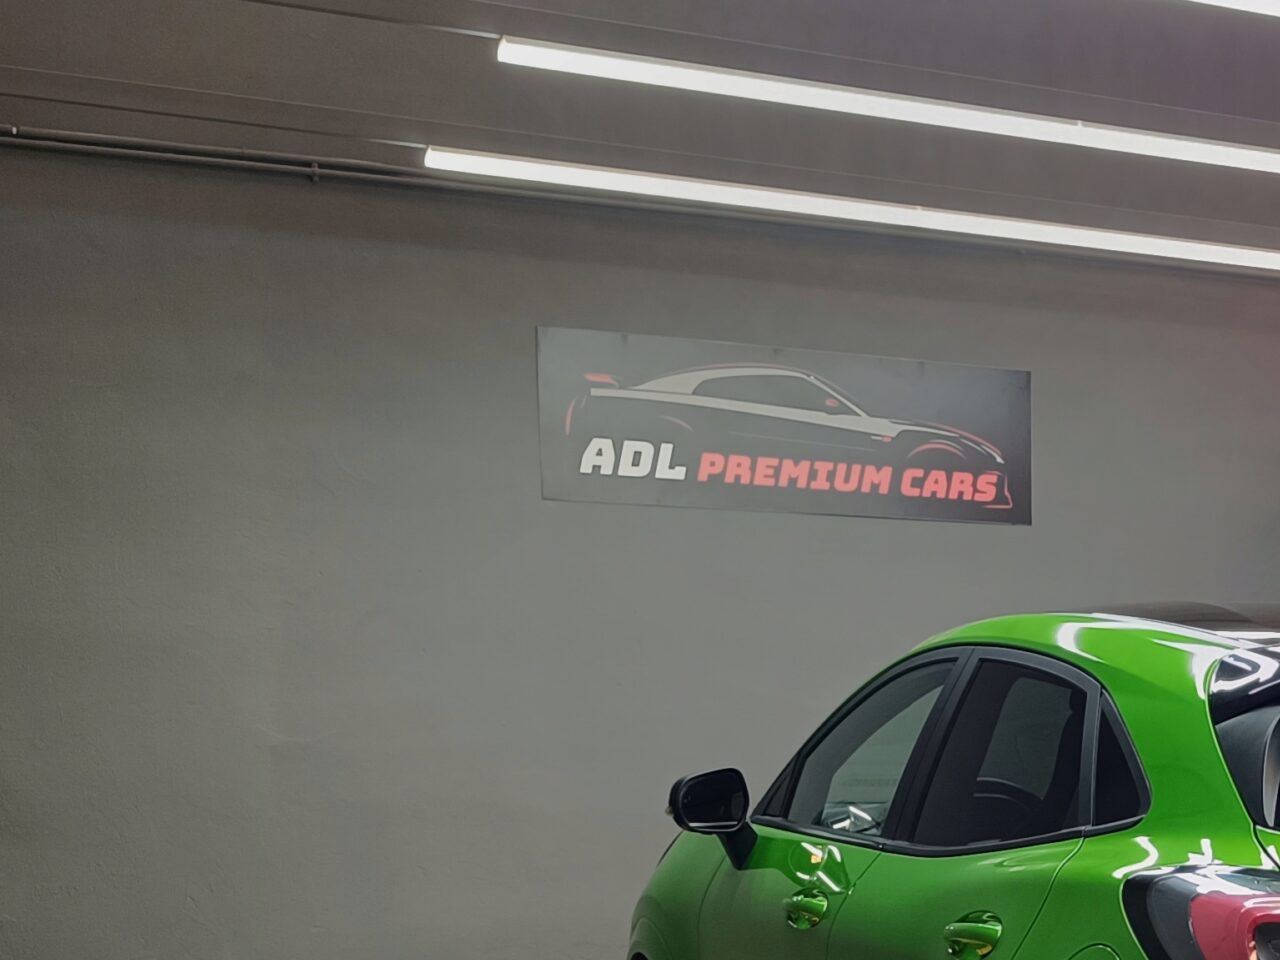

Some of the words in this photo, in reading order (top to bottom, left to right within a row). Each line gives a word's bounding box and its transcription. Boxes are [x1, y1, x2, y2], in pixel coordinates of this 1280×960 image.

[580, 438, 686, 481] ADL
[697, 453, 893, 495] PREMIUM
[901, 469, 998, 502] CARS
